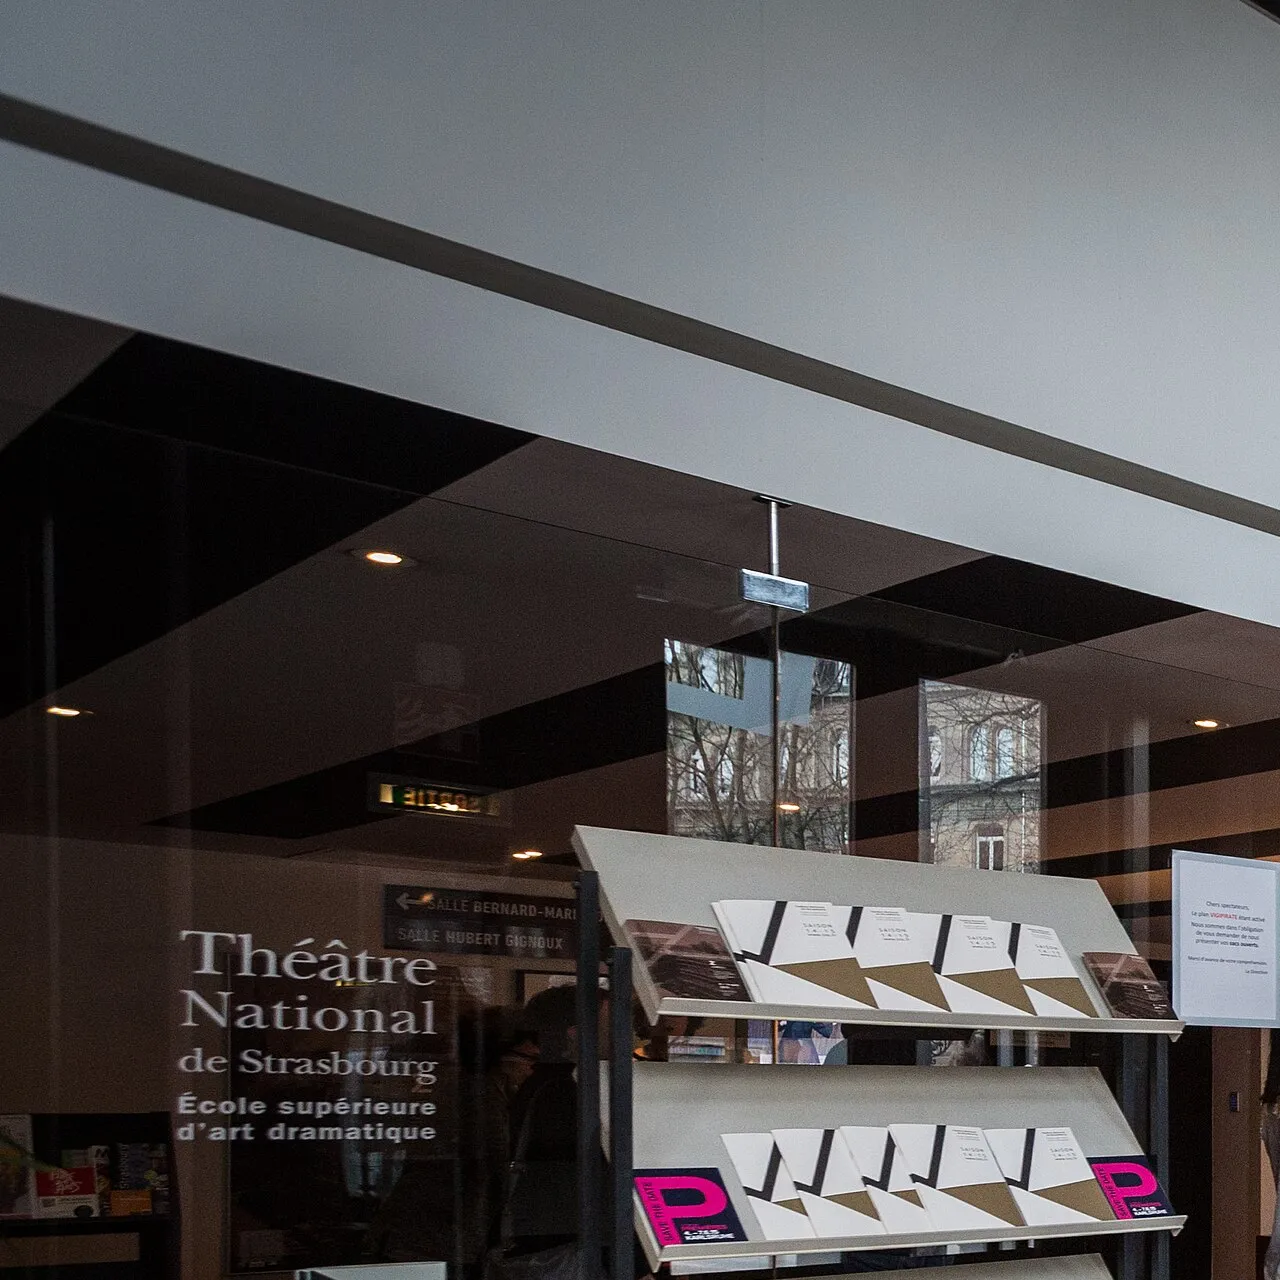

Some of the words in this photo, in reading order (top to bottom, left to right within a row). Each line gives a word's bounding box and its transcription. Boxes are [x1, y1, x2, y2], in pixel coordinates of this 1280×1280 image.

[428, 898, 469, 912] SALLE
[474, 901, 577, 920] BERNARD-MARI
[399, 927, 440, 943] SALLE
[445, 930, 500, 947] HUBERT
[505, 934, 564, 950] GIGNOUX
[178, 929, 438, 987] Théâtre
[179, 989, 438, 1035] National
[178, 1047, 229, 1073] de
[238, 1048, 439, 1085] Strasbourg
[177, 1092, 267, 1116] École
[277, 1097, 438, 1119] supérieure
[177, 1122, 255, 1142] d'art
[266, 1122, 438, 1144] dramatique
[642, 1182, 659, 1202] DATE
